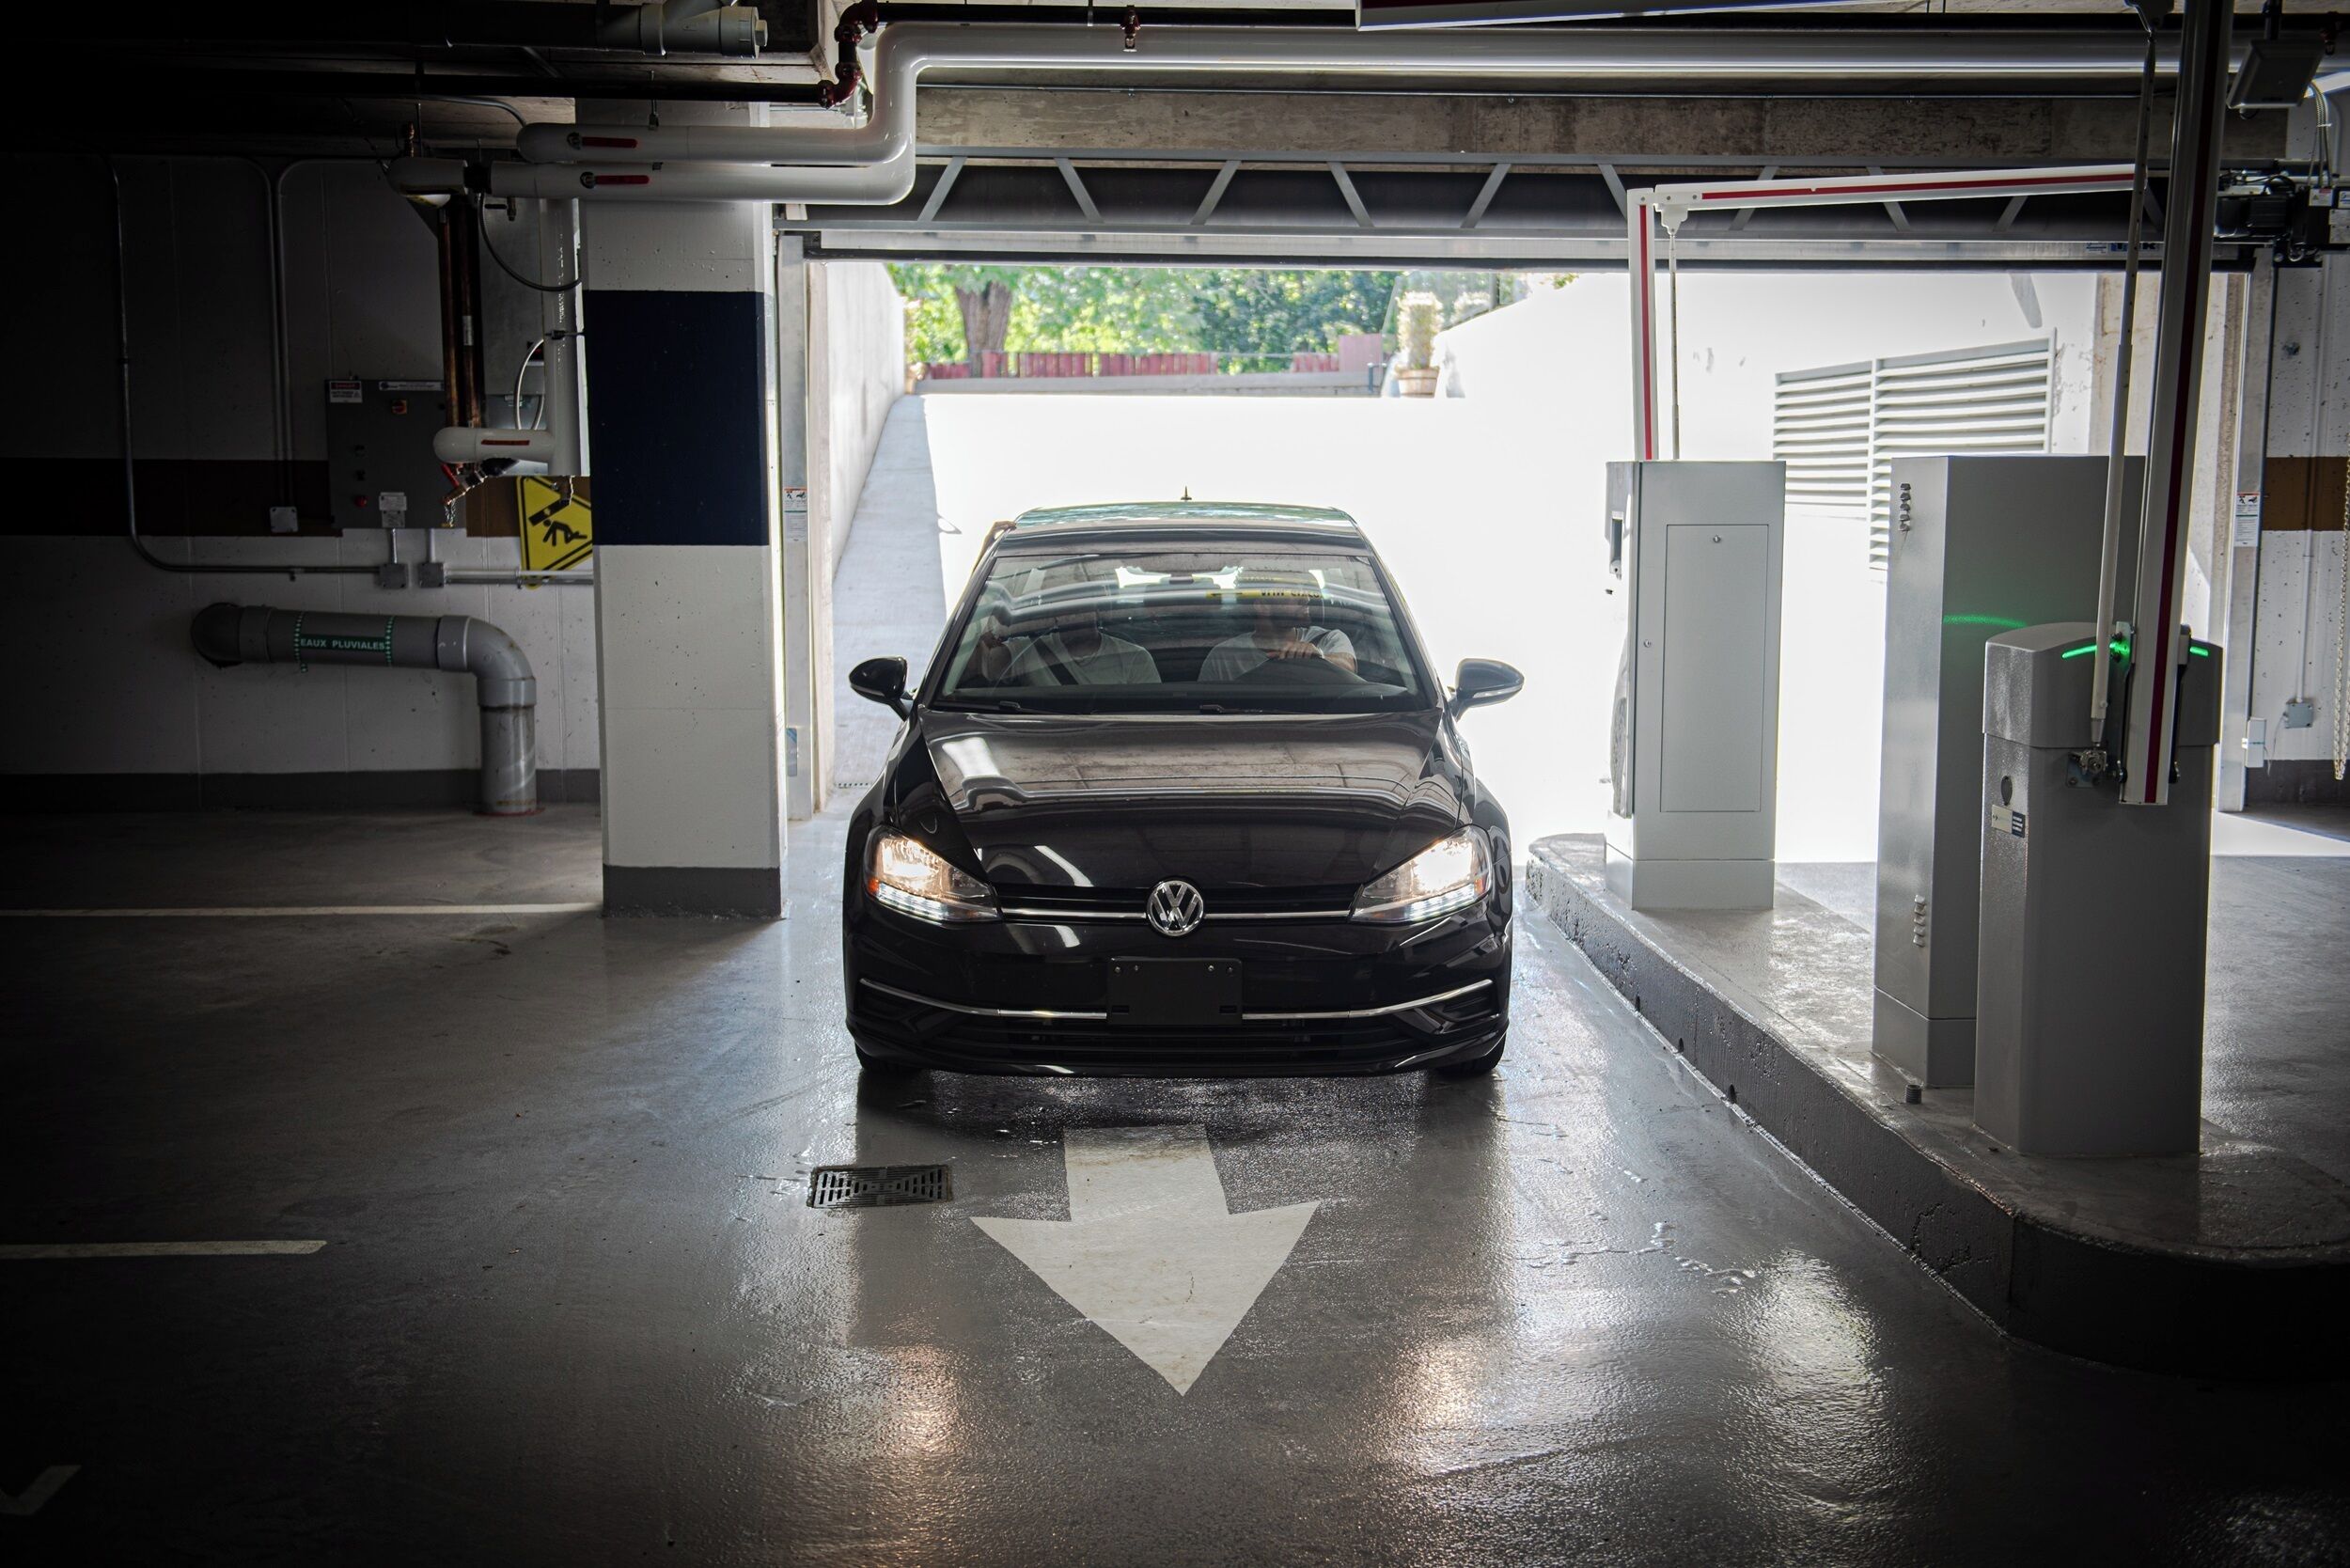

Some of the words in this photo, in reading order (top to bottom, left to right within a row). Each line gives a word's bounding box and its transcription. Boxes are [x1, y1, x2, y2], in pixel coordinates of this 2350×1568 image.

[300, 638, 326, 648] EAUX
[332, 640, 385, 651] PLUVIALES
[1148, 881, 1203, 935] VW
